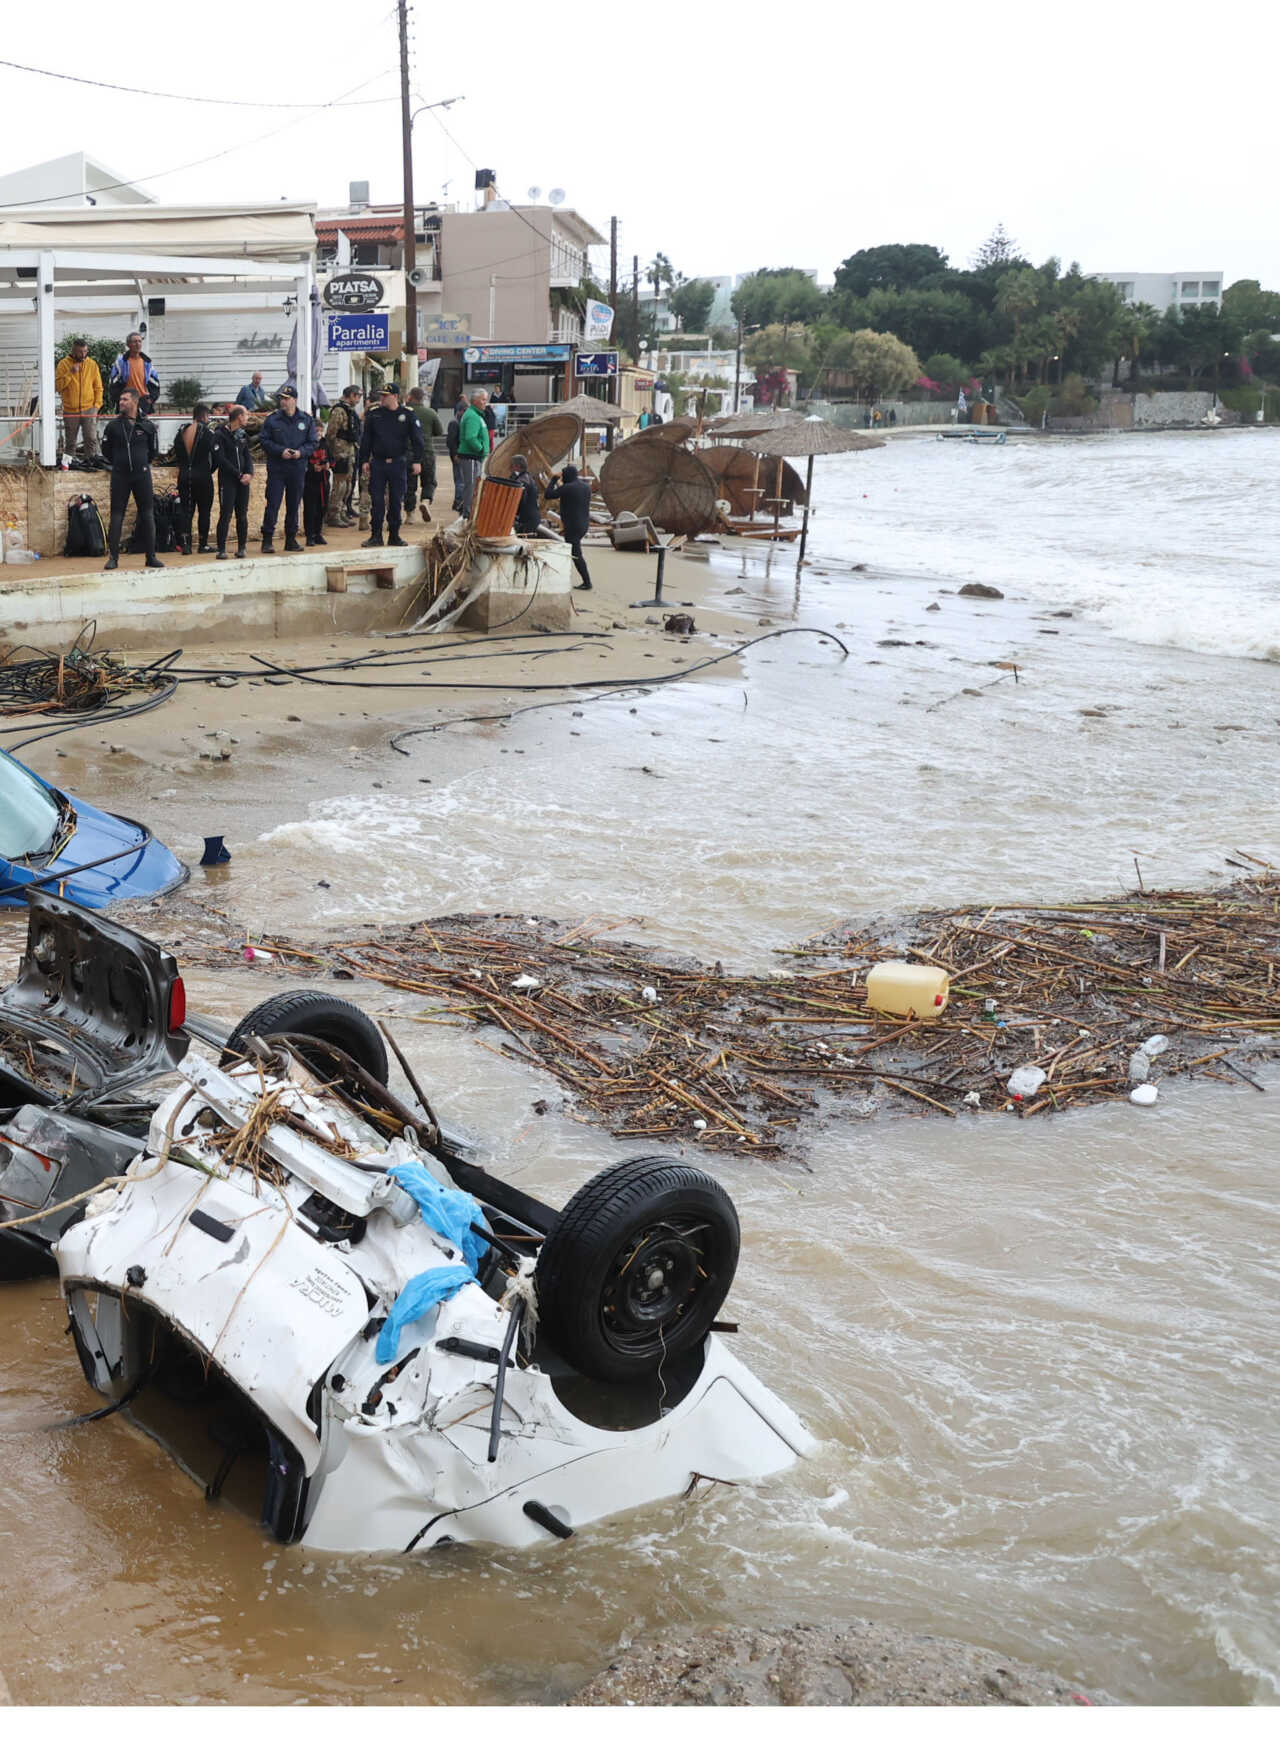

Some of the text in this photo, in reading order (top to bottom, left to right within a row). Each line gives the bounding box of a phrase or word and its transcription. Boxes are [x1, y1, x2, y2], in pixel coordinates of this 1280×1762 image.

[329, 280, 378, 294] PIATSA
[332, 324, 385, 341] Paralia
[335, 339, 380, 348] apartments
